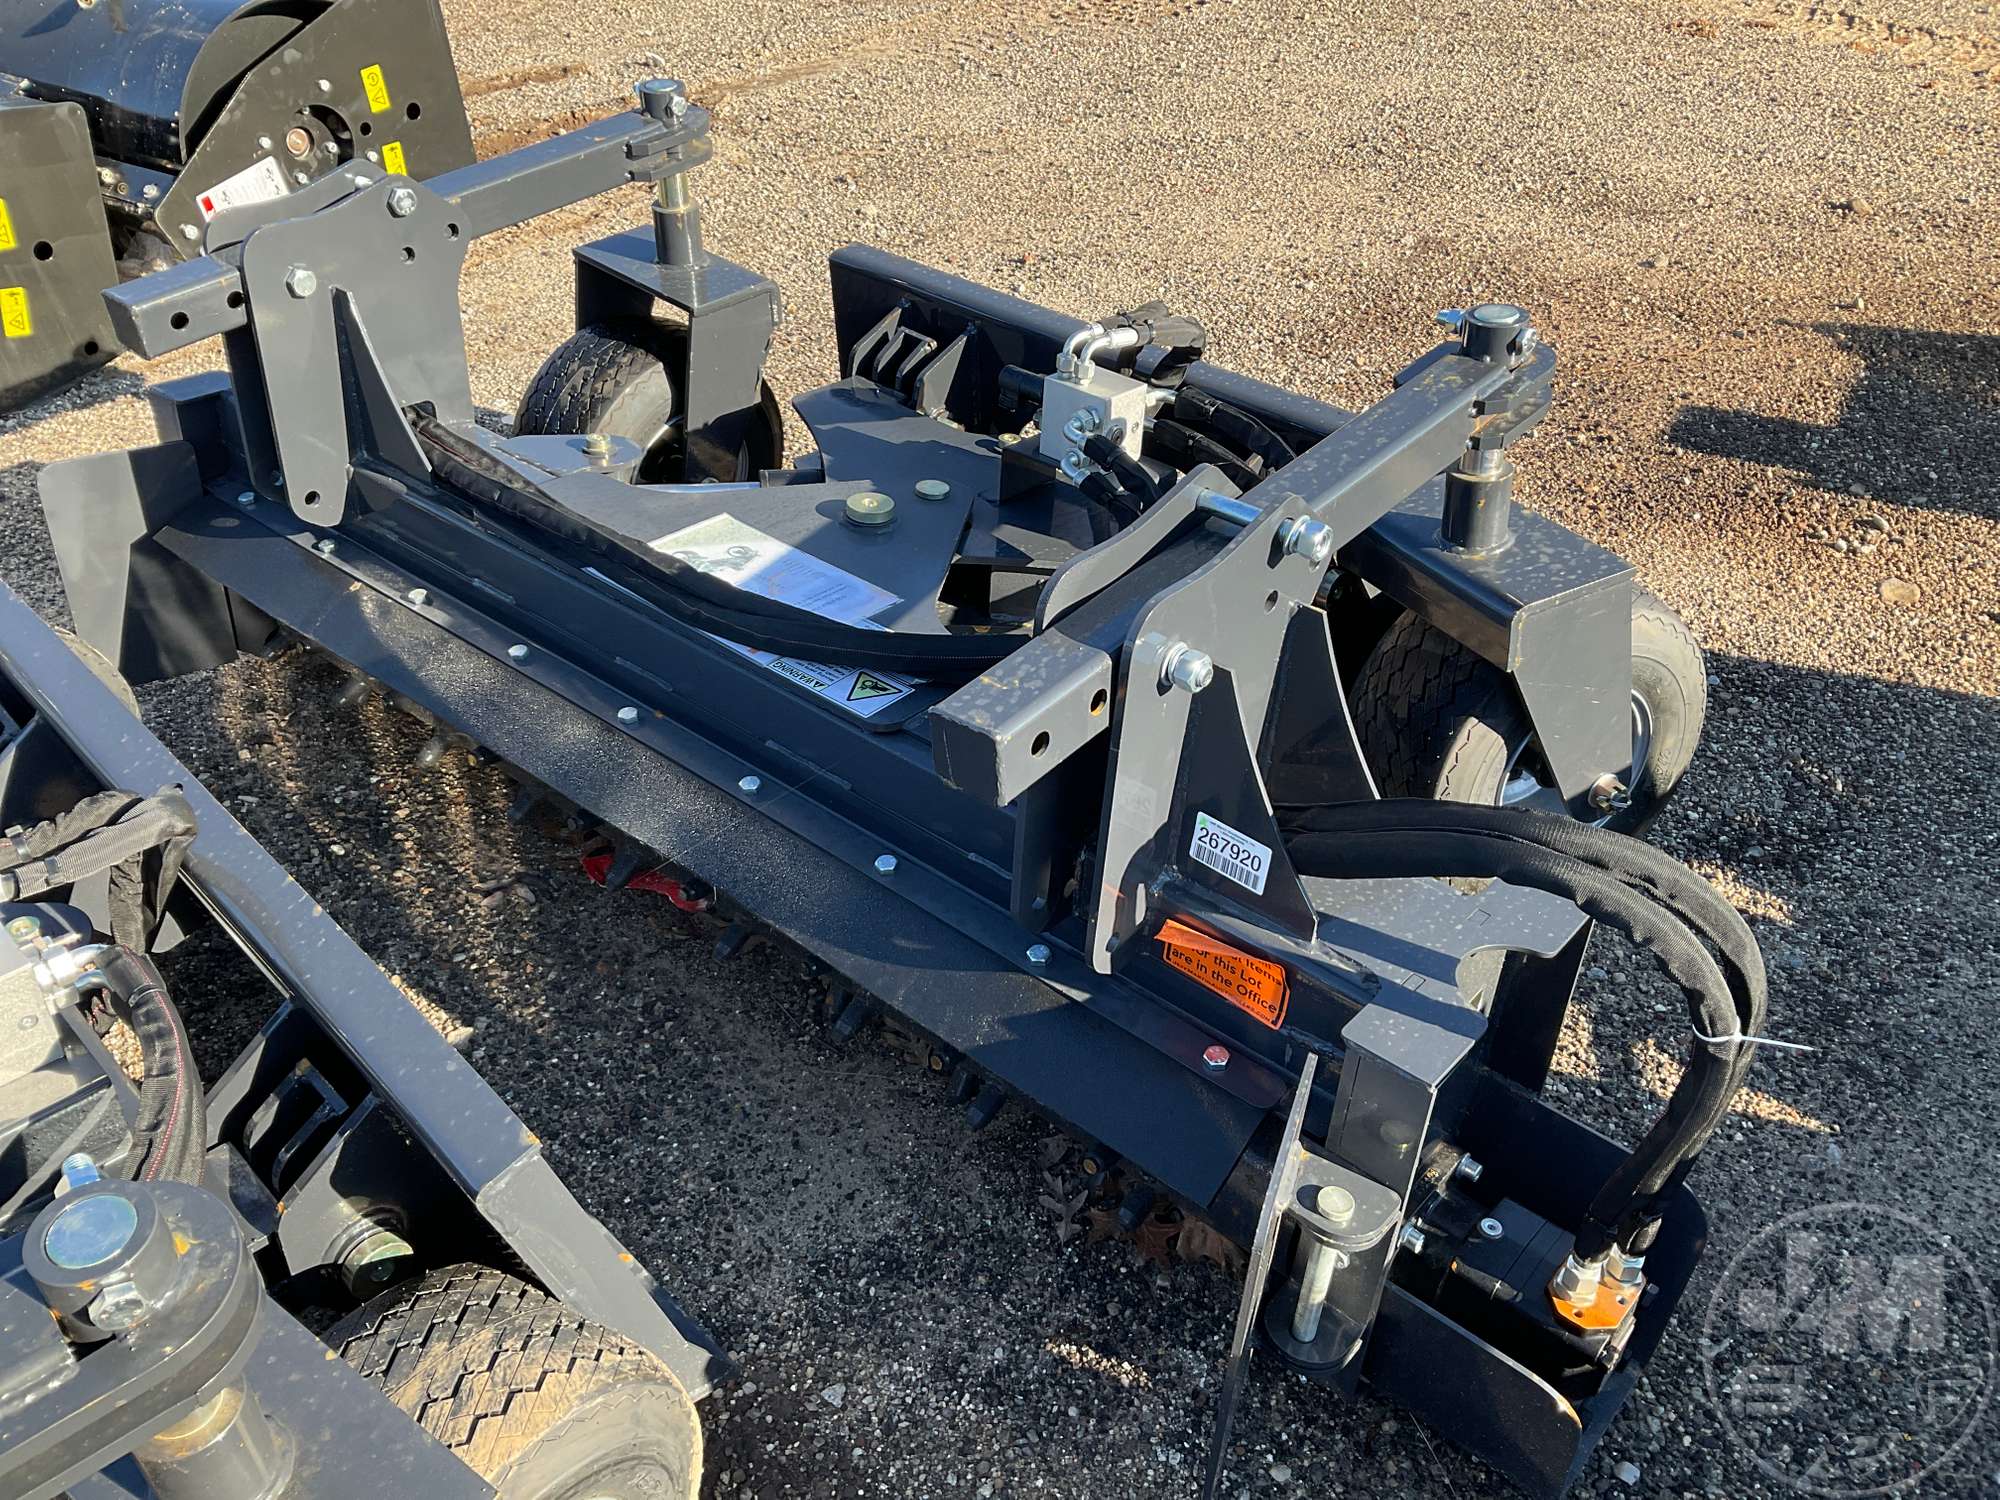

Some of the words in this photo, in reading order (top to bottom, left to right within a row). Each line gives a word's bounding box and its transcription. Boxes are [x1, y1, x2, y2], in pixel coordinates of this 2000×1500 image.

[773, 661, 815, 685] WARNING
[1198, 827, 1262, 872] 267920
[1172, 948, 1193, 964] are
[1196, 960, 1208, 975] in
[1211, 969, 1233, 988] the
[1236, 984, 1277, 1014] Office
[1214, 956, 1236, 975] this
[1240, 969, 1262, 989] Lot
[1246, 958, 1282, 986] Items
